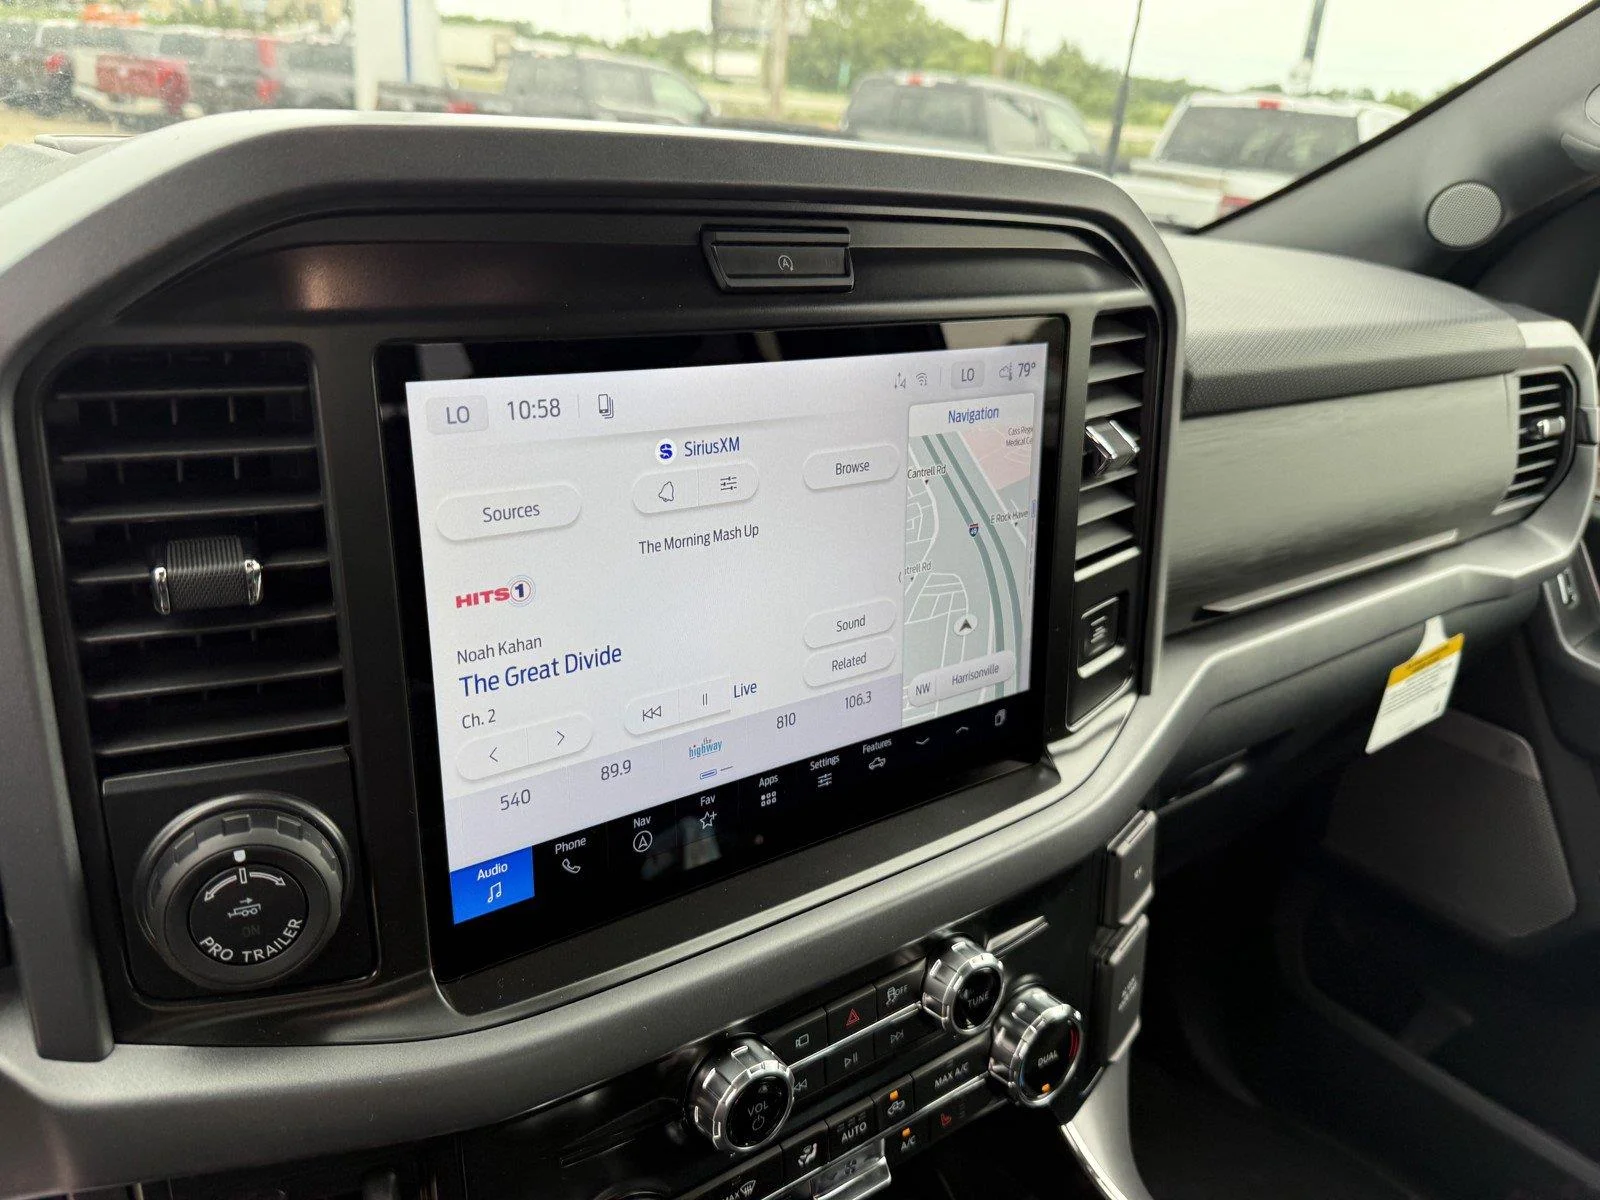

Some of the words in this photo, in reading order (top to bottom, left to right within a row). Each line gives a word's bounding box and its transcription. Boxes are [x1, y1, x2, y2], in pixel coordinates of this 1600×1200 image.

[961, 368, 975, 383] LO
[446, 405, 470, 425] LO
[506, 398, 561, 421] 10:58
[948, 406, 999, 424] Navigation
[684, 436, 740, 457] SiriusXM
[835, 460, 870, 475] Browse
[907, 466, 935, 479] Cantrell
[936, 465, 946, 475] Rd
[482, 503, 540, 523] Sources
[639, 540, 661, 555] The
[664, 532, 711, 550] Morning
[713, 527, 742, 542] Mash
[744, 524, 760, 538] Up
[836, 615, 866, 632] Sound
[457, 644, 495, 664] Noah
[498, 636, 543, 655] Kahan
[459, 674, 500, 697] The
[505, 658, 560, 687] Great
[565, 645, 622, 674] Divide
[831, 652, 867, 672] Related
[951, 664, 999, 685] Harrisonville
[733, 682, 758, 698] Live
[915, 682, 931, 696] NW
[845, 691, 872, 710] 106.3
[462, 713, 484, 729] Ch.
[488, 709, 496, 724] 2
[776, 712, 796, 729] 810
[689, 741, 723, 758] highway
[862, 737, 892, 754] Features
[600, 759, 632, 781] 89.9
[810, 754, 840, 772] Settings
[759, 774, 779, 788] Apps
[500, 789, 531, 811] 540
[700, 793, 716, 807] Fav
[633, 816, 651, 828] Nav
[555, 836, 587, 854] Phone
[477, 862, 508, 881] Audio
[200, 936, 234, 962] PRO
[242, 918, 303, 963] TRAILER
[967, 991, 989, 1009] TUNE
[1037, 1050, 1059, 1069] DUAL
[935, 1070, 953, 1088] MAX
[955, 1061, 970, 1076] A/C
[747, 1100, 769, 1117] VOL
[841, 1121, 867, 1144] AUTO
[900, 1135, 916, 1152] A/C
